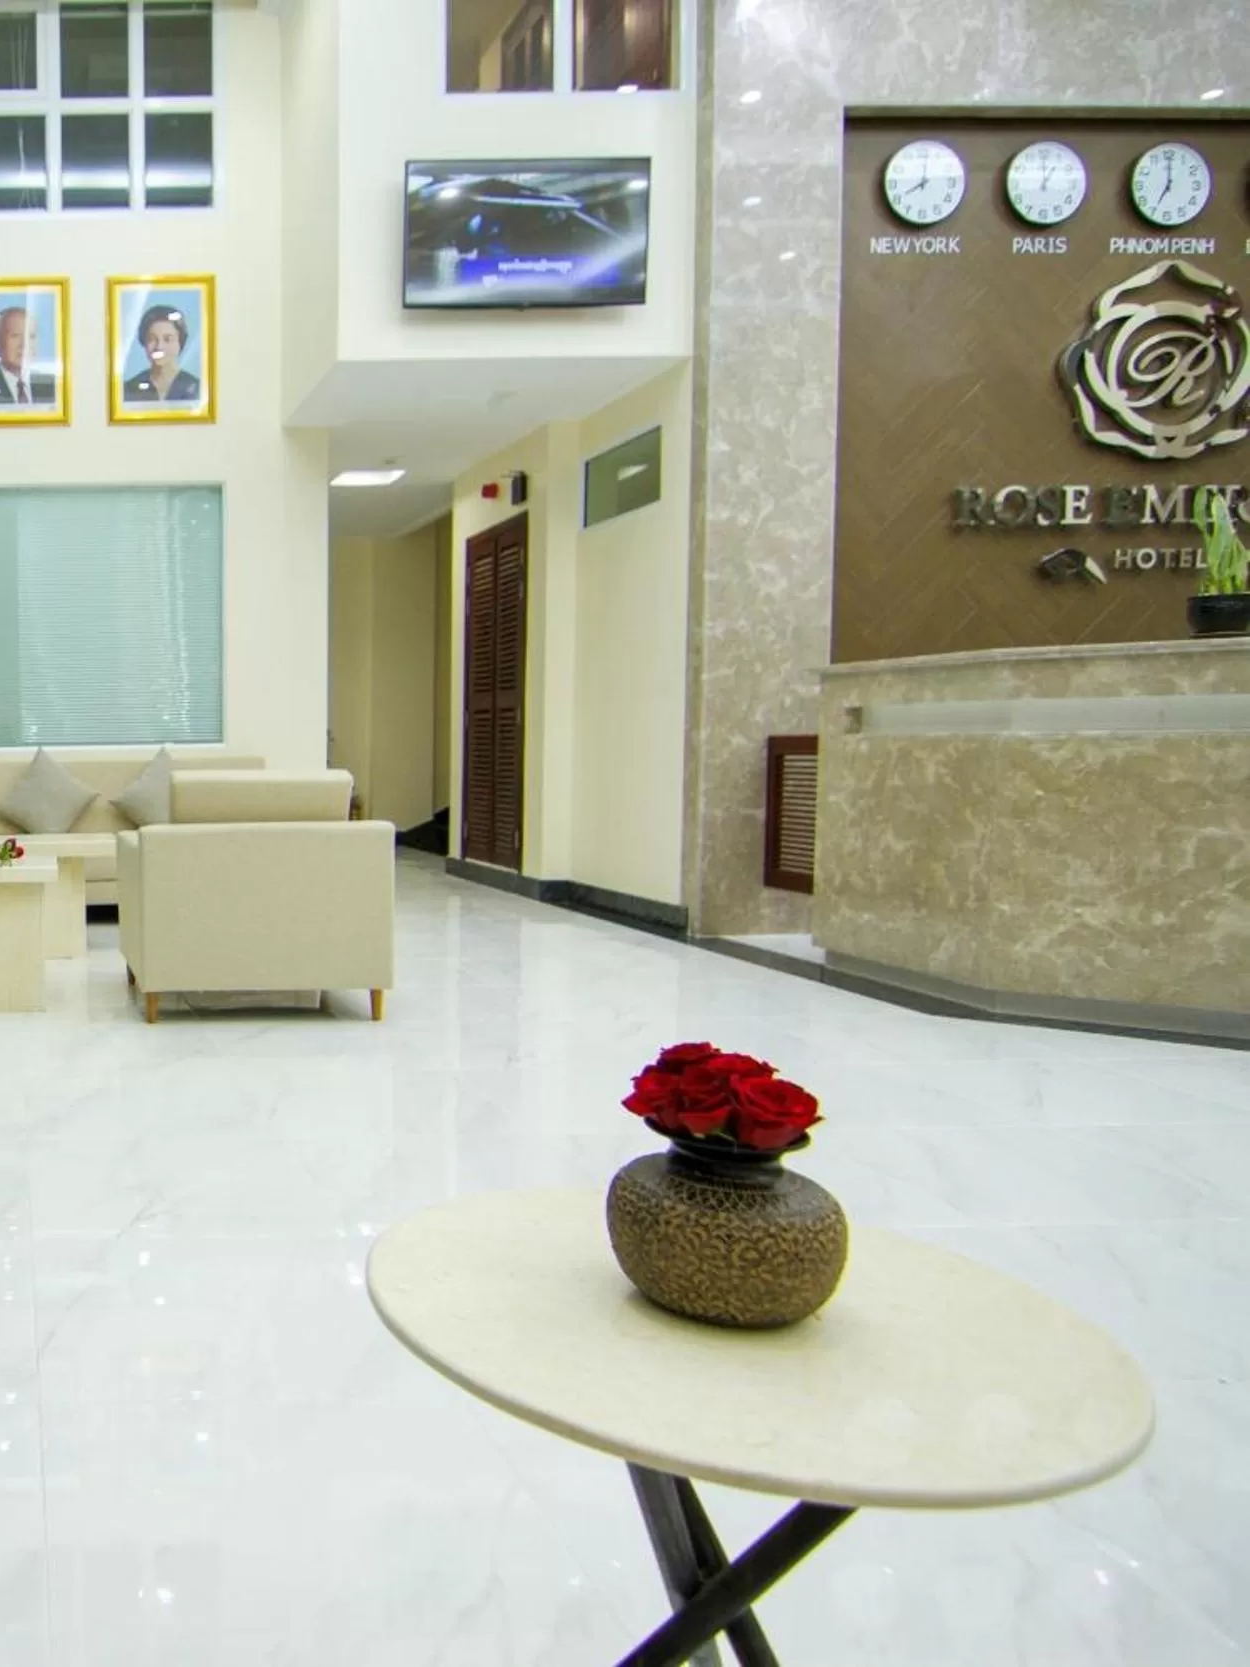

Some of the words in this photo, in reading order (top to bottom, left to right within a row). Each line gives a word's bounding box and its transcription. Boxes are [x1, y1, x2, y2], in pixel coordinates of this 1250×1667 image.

[869, 236, 911, 254] NEW
[911, 235, 961, 254] YORK
[1012, 236, 1067, 254] PARIS
[1109, 236, 1170, 254] PHNOM
[1171, 237, 1215, 254] PENH
[953, 484, 1094, 526] ROSE
[1113, 547, 1209, 570] HOTEL
